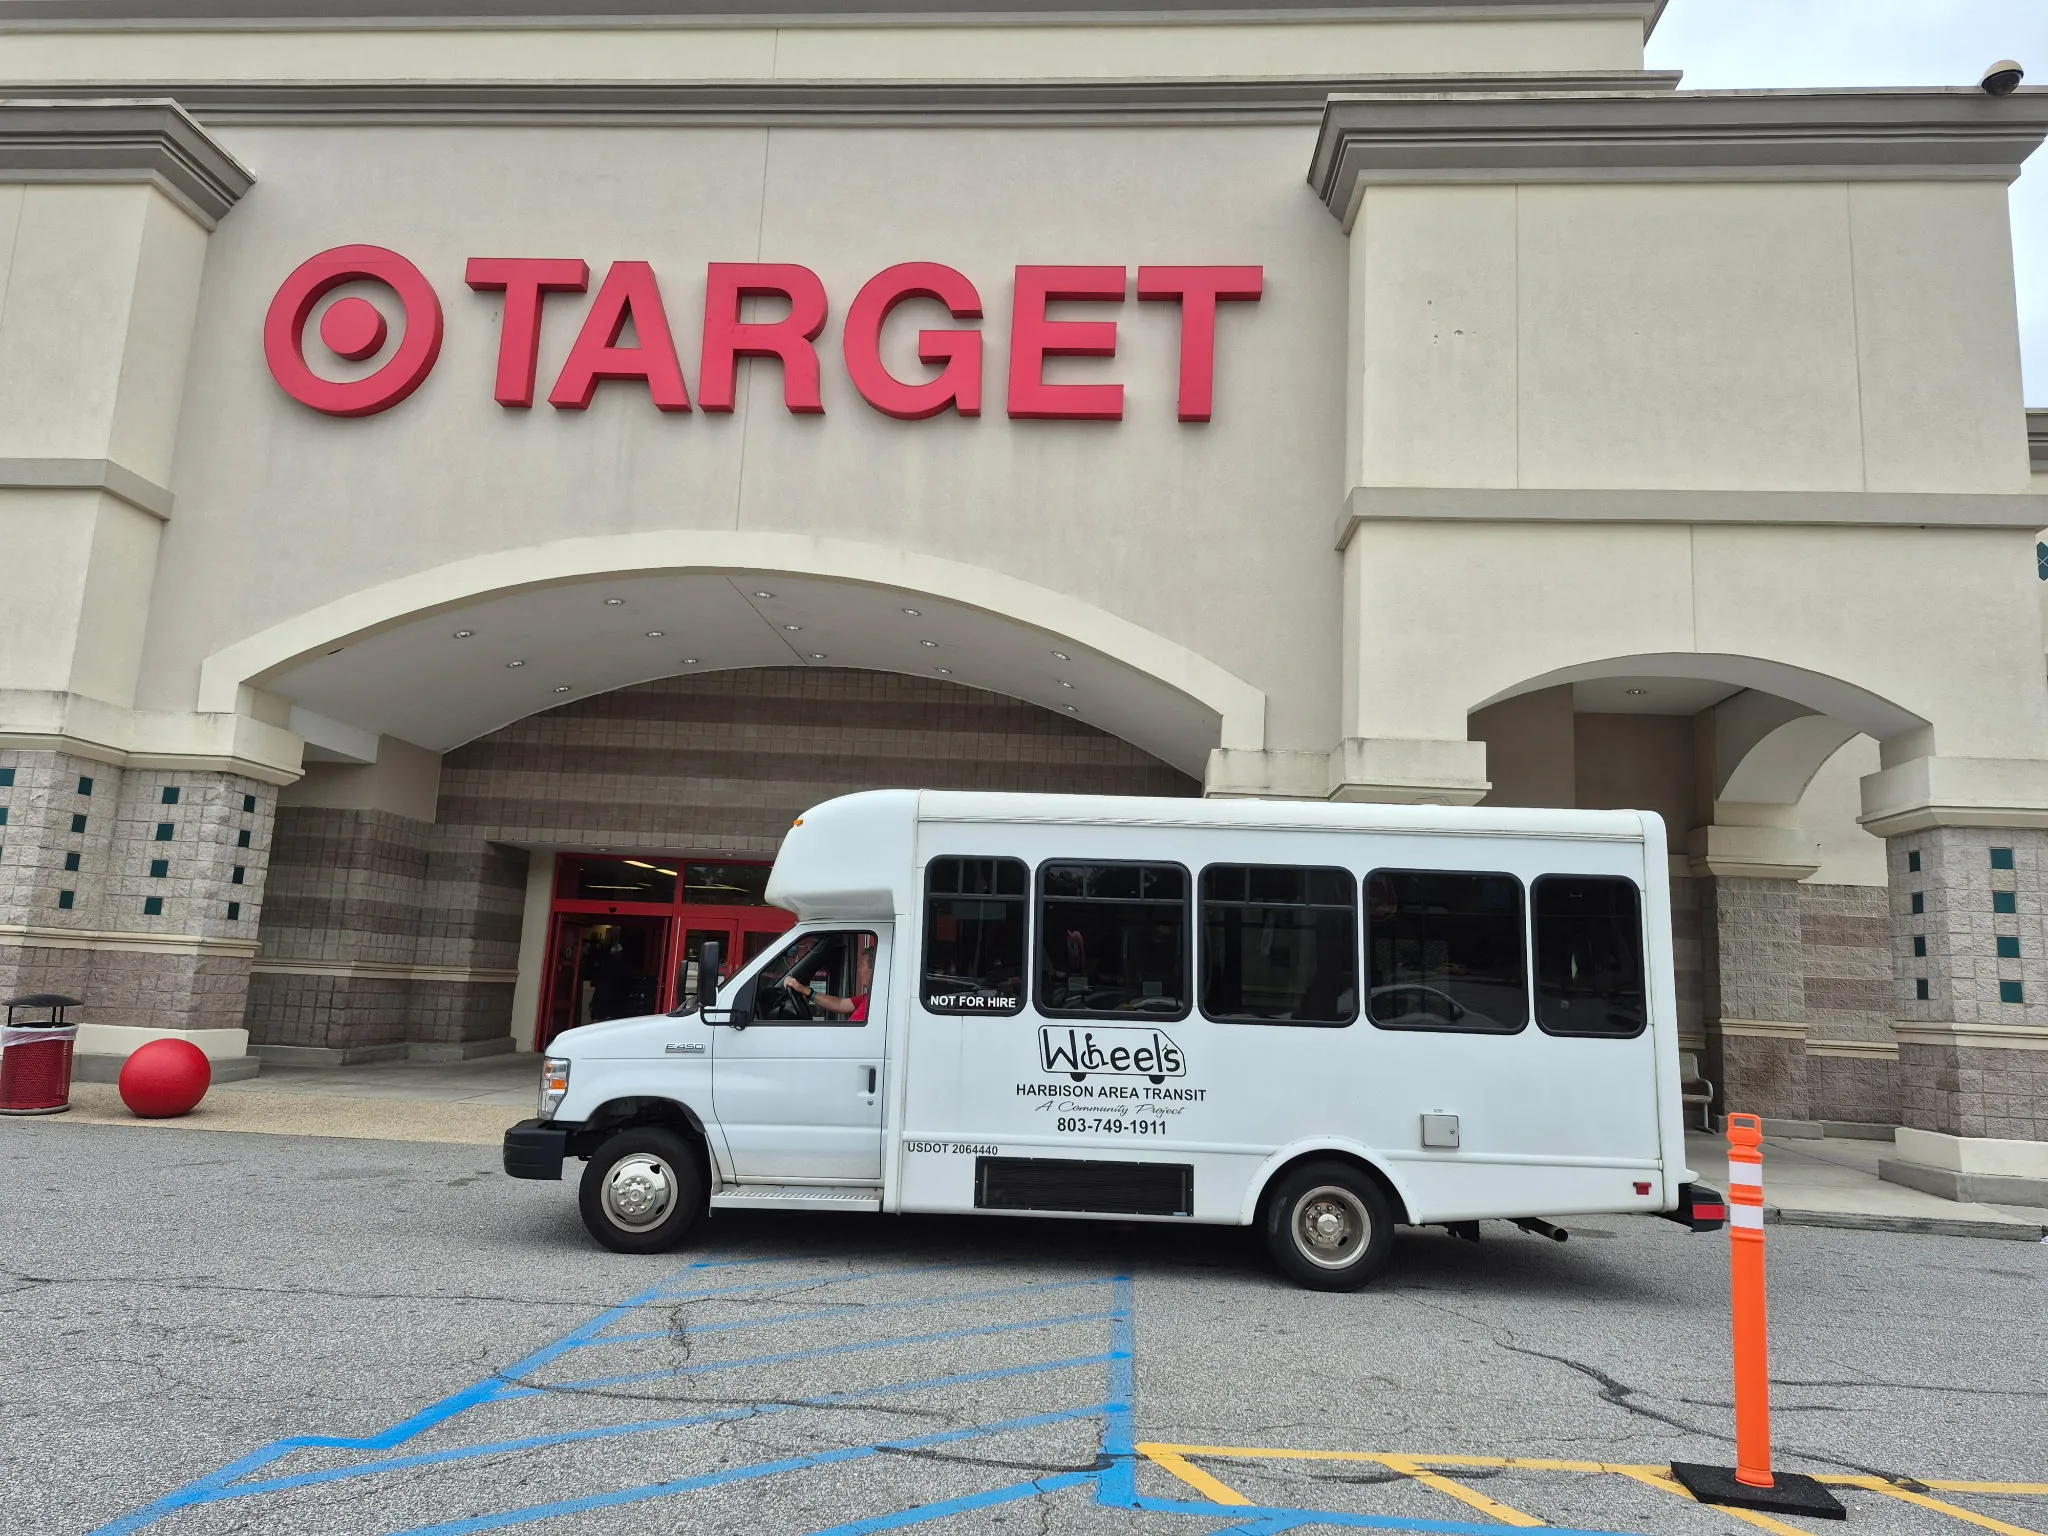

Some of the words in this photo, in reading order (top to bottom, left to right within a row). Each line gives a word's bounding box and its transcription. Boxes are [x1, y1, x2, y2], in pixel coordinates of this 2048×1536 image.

[465, 257, 1263, 423] TARGET
[930, 995, 956, 1007] NOT
[959, 996, 985, 1007] FOR
[987, 997, 1017, 1008] HIRE
[1016, 1083, 1094, 1097] HARBISON
[1098, 1086, 1139, 1099] AREA
[1143, 1088, 1207, 1101] TRANSIT
[1035, 1100, 1053, 1112] A
[1058, 1101, 1129, 1117] Community
[1134, 1103, 1188, 1118] Project
[1057, 1117, 1167, 1135] 803-749-1911
[907, 1142, 949, 1153] USDOT
[951, 1143, 998, 1155] 2064440
